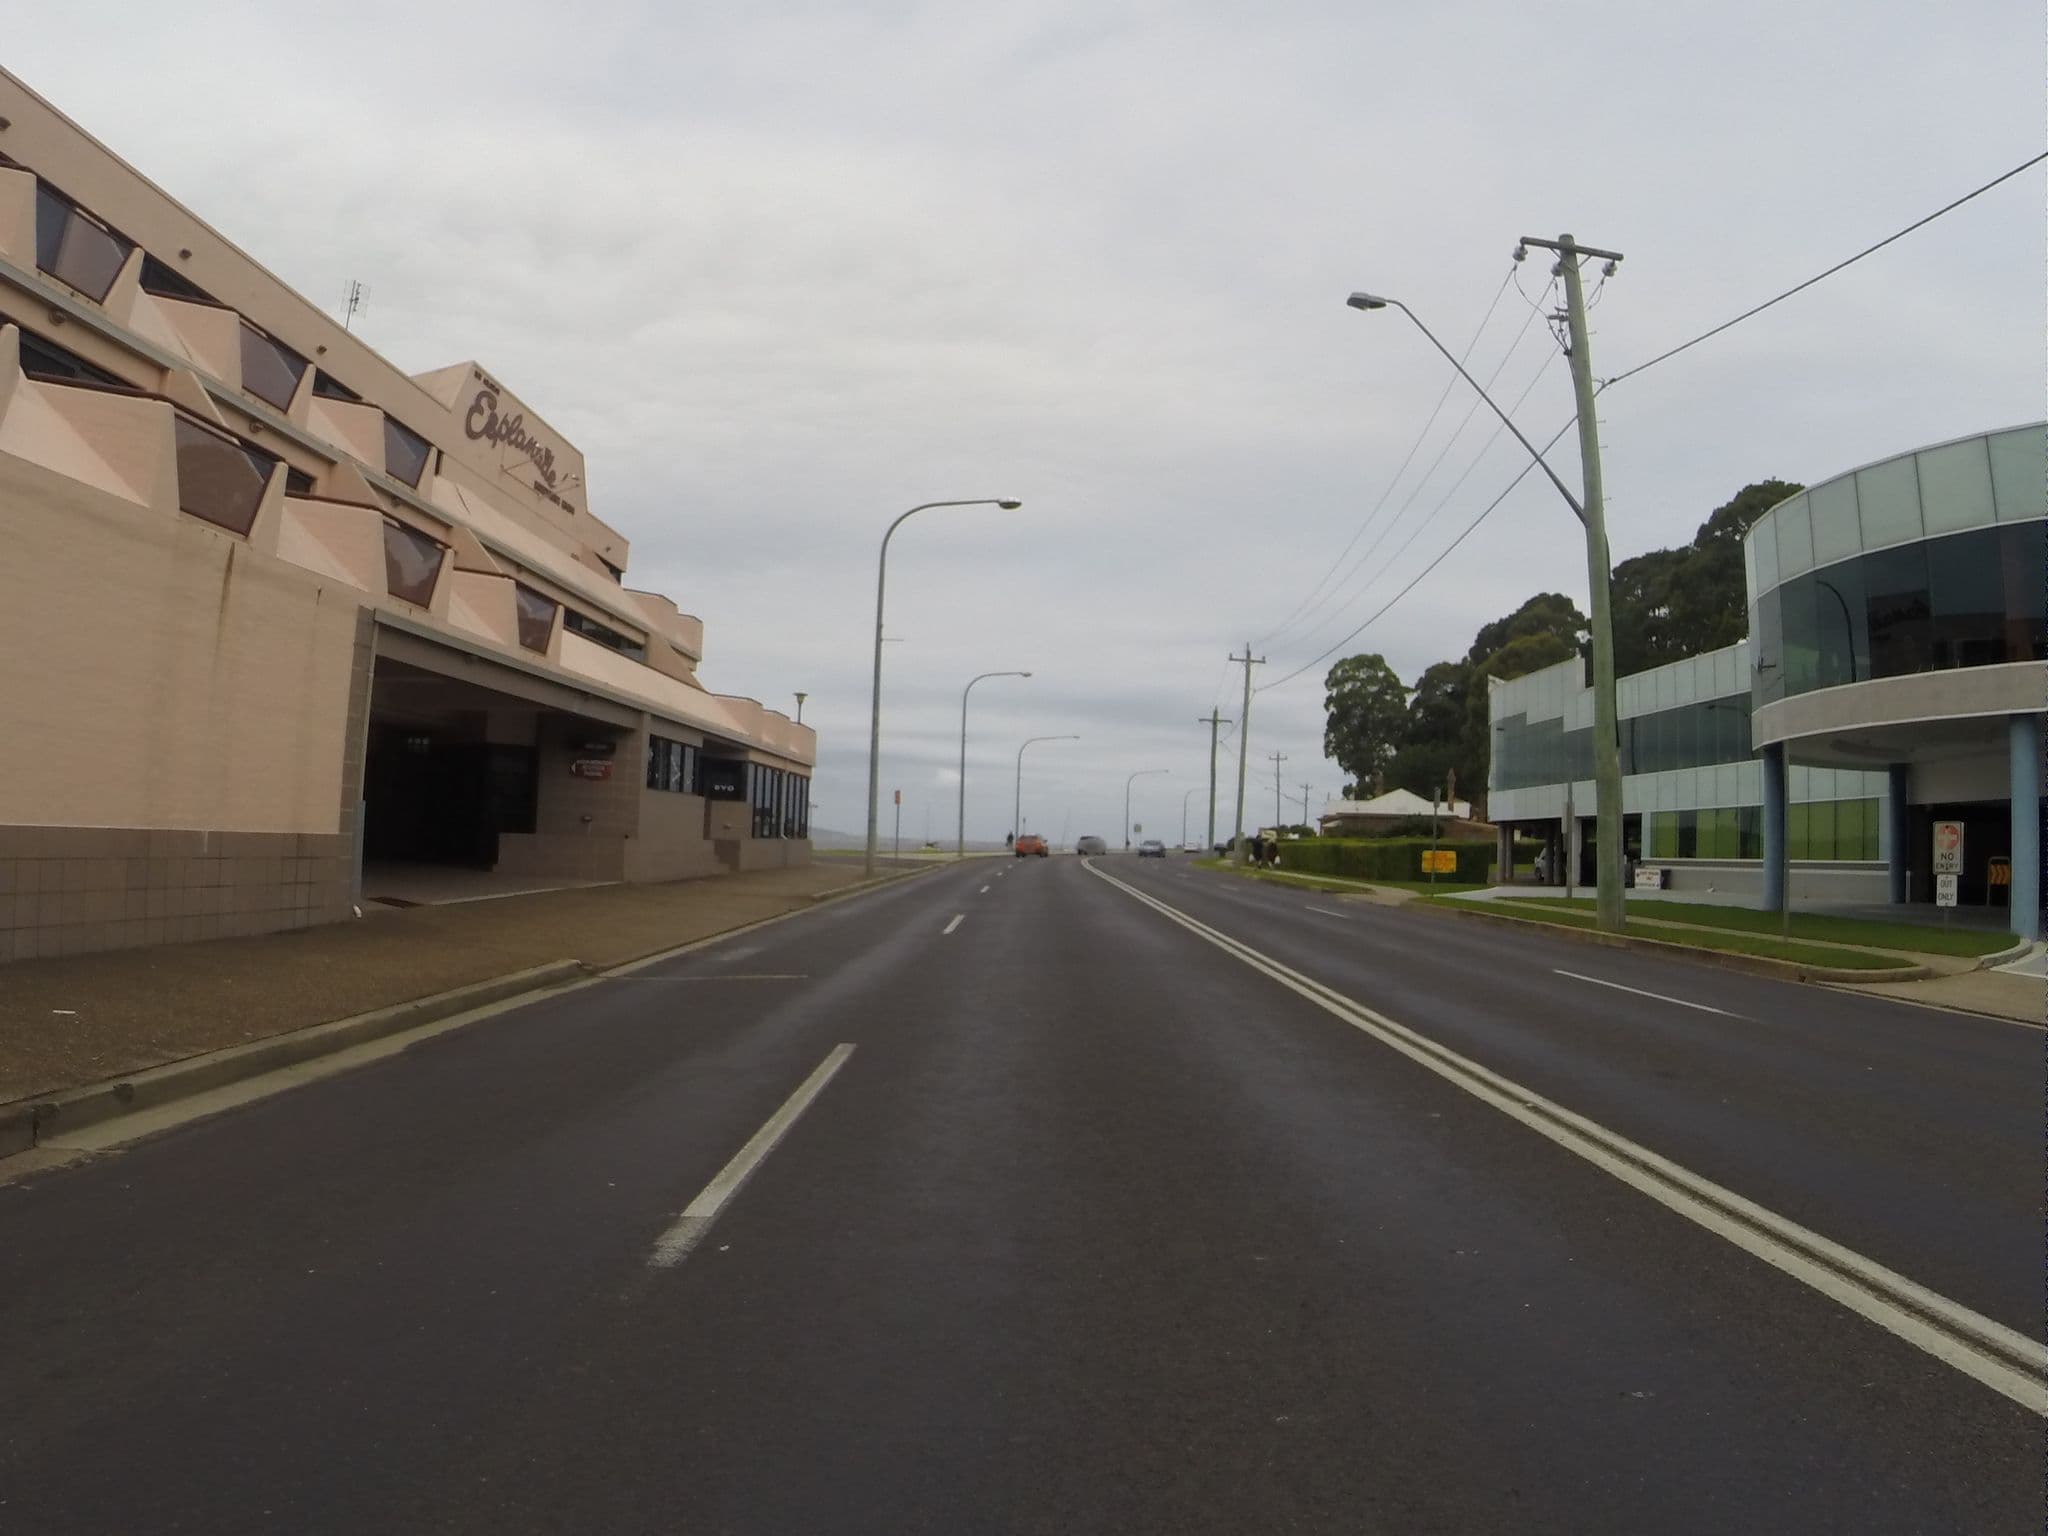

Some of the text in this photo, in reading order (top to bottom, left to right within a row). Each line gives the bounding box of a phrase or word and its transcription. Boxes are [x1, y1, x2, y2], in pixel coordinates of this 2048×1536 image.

[466, 391, 557, 487] Esplanade
[1940, 852, 1954, 861] NO
[1940, 880, 1952, 888] OUT
[1938, 893, 1954, 901] ONLY
